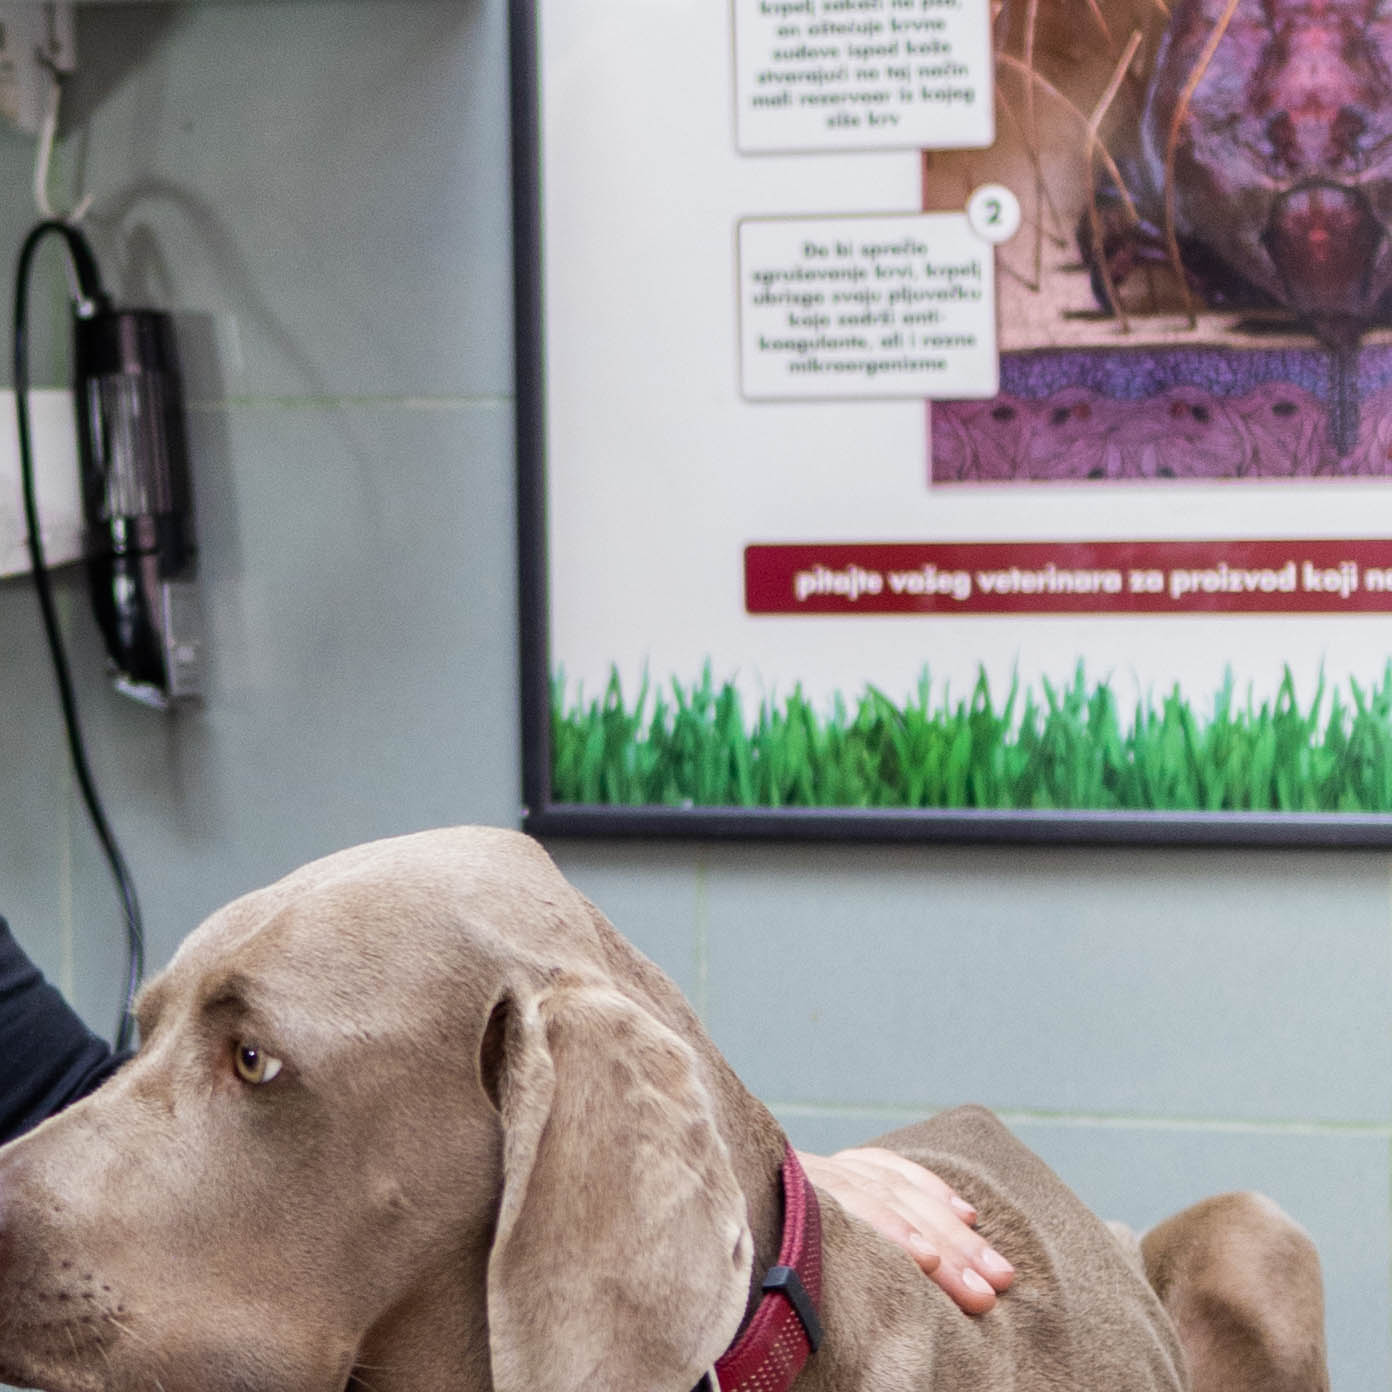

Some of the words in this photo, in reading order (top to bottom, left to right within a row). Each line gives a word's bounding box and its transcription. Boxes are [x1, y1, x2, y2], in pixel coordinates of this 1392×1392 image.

[984, 199, 1002, 224] 2
[795, 563, 884, 601] pitajte
[888, 562, 972, 601] vašeg
[975, 562, 1122, 594] veterinara
[1128, 568, 1164, 594] za
[1169, 560, 1297, 600] proizvod
[1302, 560, 1358, 599] koji
